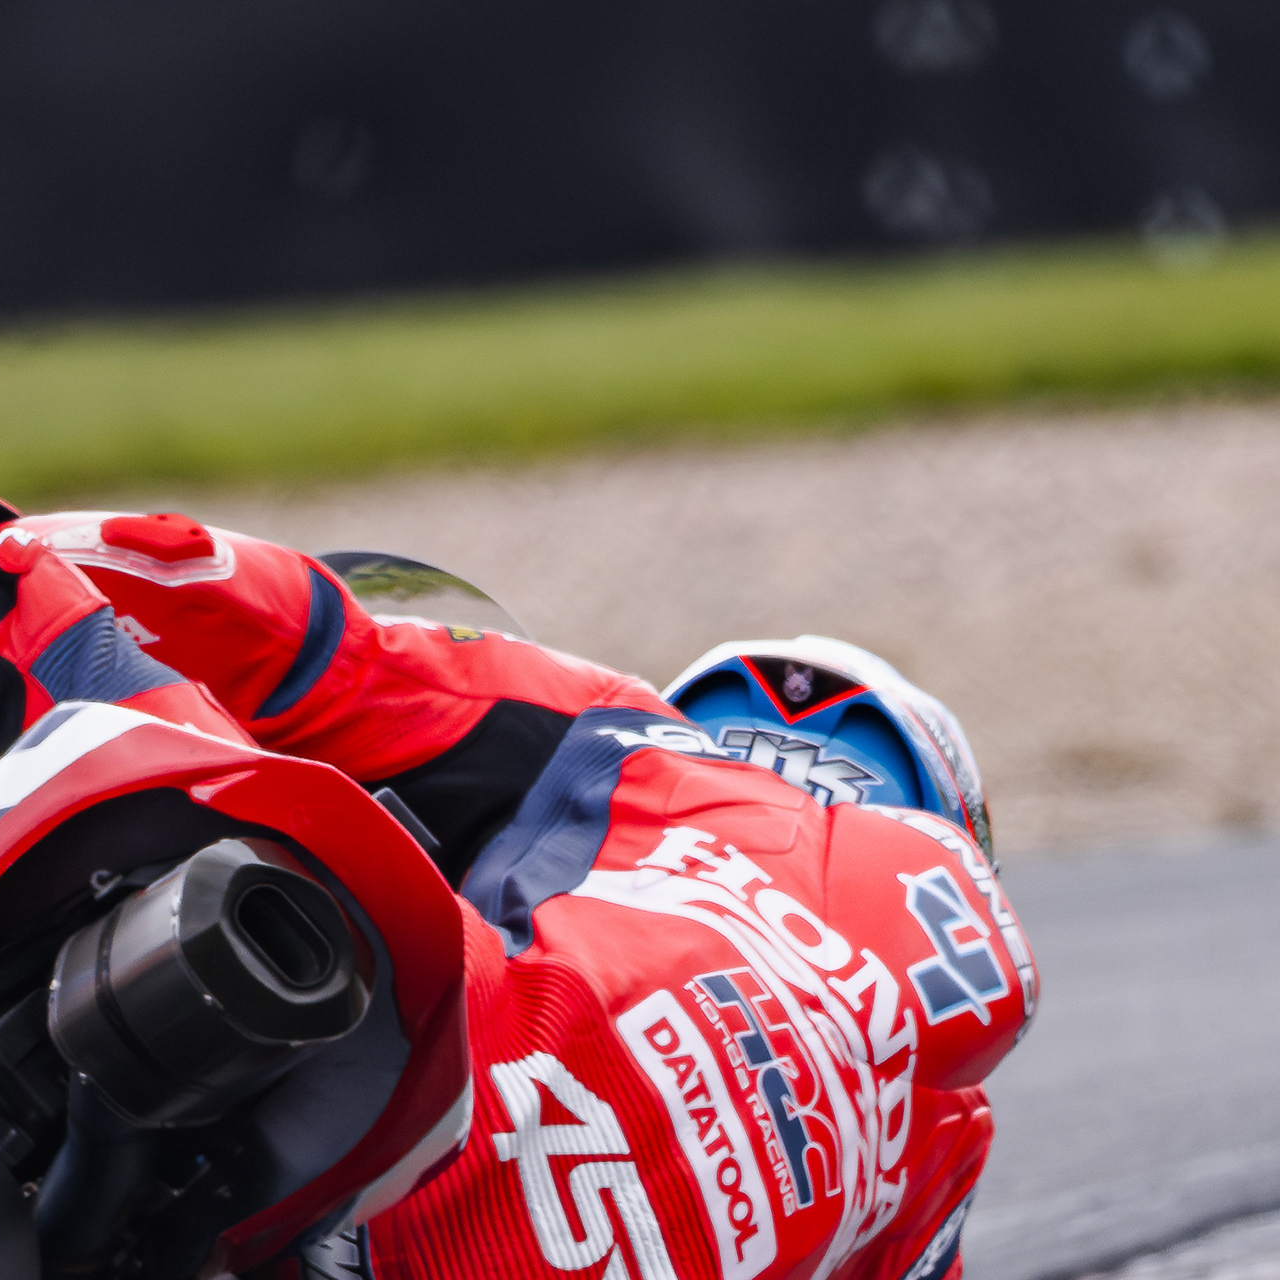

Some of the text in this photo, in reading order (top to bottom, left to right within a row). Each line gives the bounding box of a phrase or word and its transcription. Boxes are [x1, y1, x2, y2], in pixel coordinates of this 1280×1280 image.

[637, 826, 919, 1250] HONDA
[642, 1016, 759, 1264] DATATOOL
[746, 1094, 797, 1218] RACING
